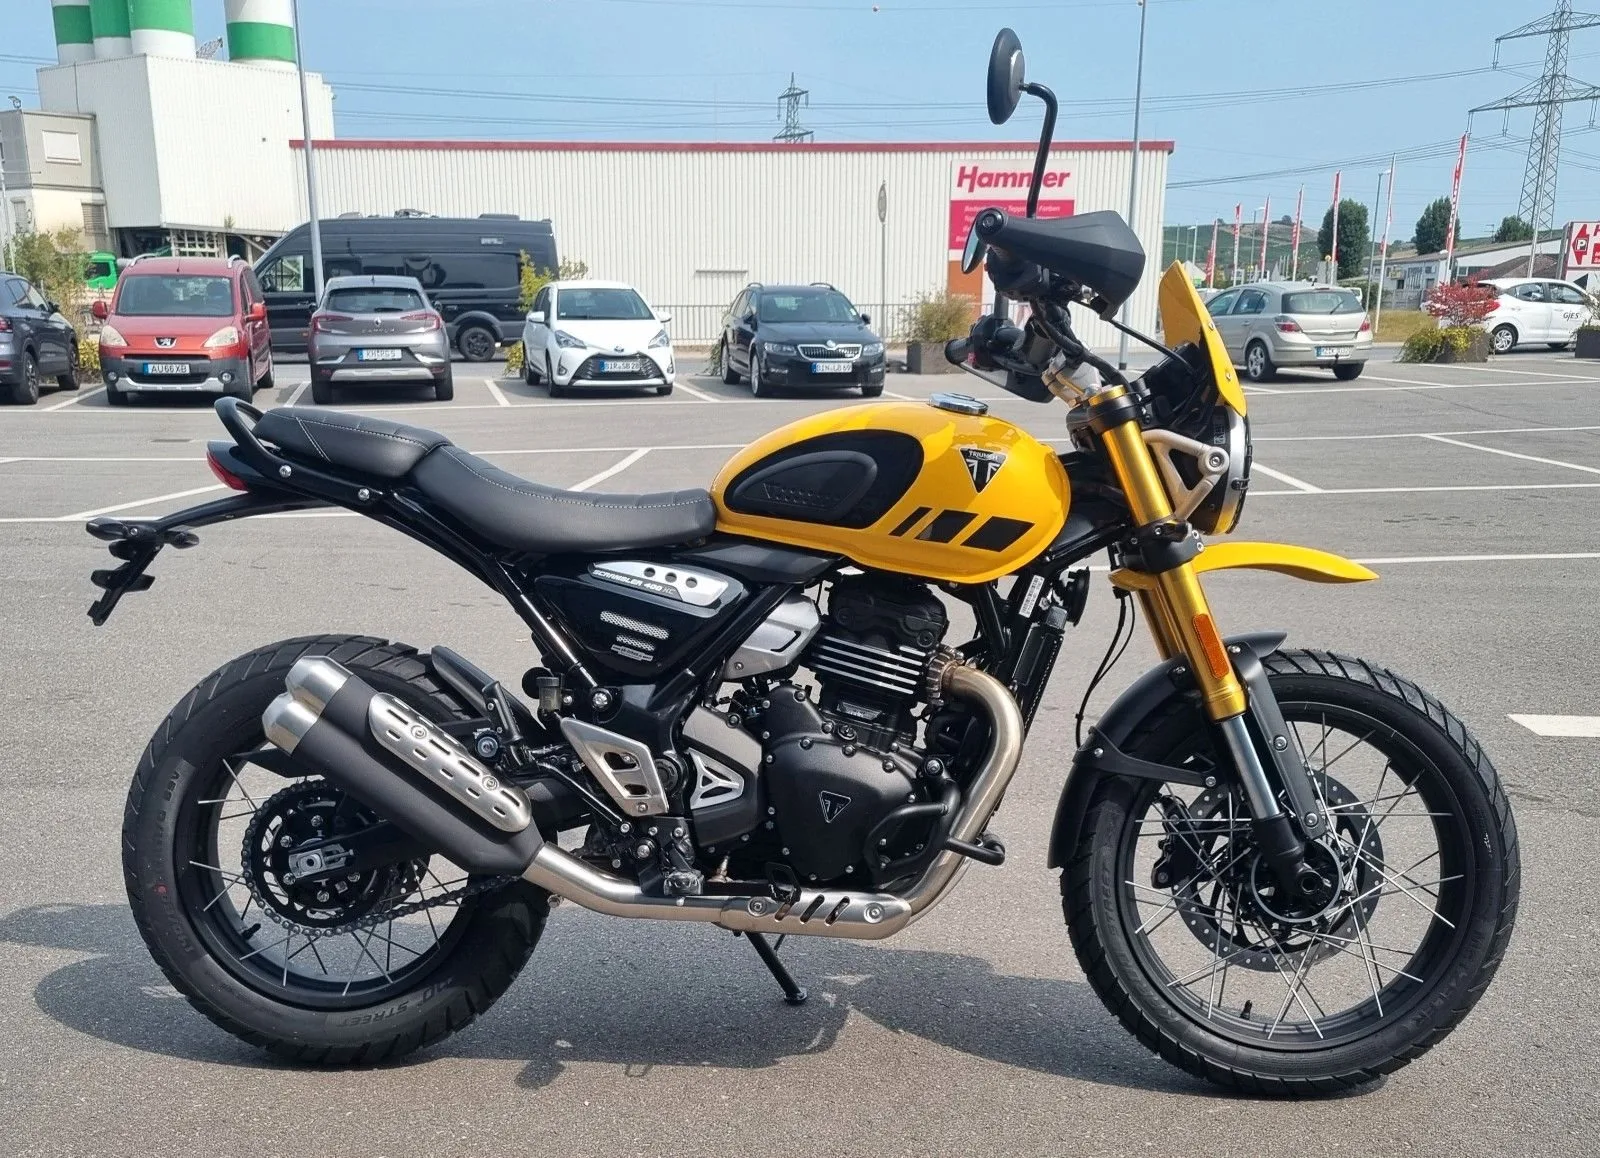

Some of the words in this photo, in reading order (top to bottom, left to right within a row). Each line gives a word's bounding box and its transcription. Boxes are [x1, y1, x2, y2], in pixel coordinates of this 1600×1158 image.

[968, 451, 998, 461] TRIUMPH
[592, 569, 643, 586] SCRAMBLER
[643, 582, 662, 592] 400
[336, 1001, 409, 1027] STREET
